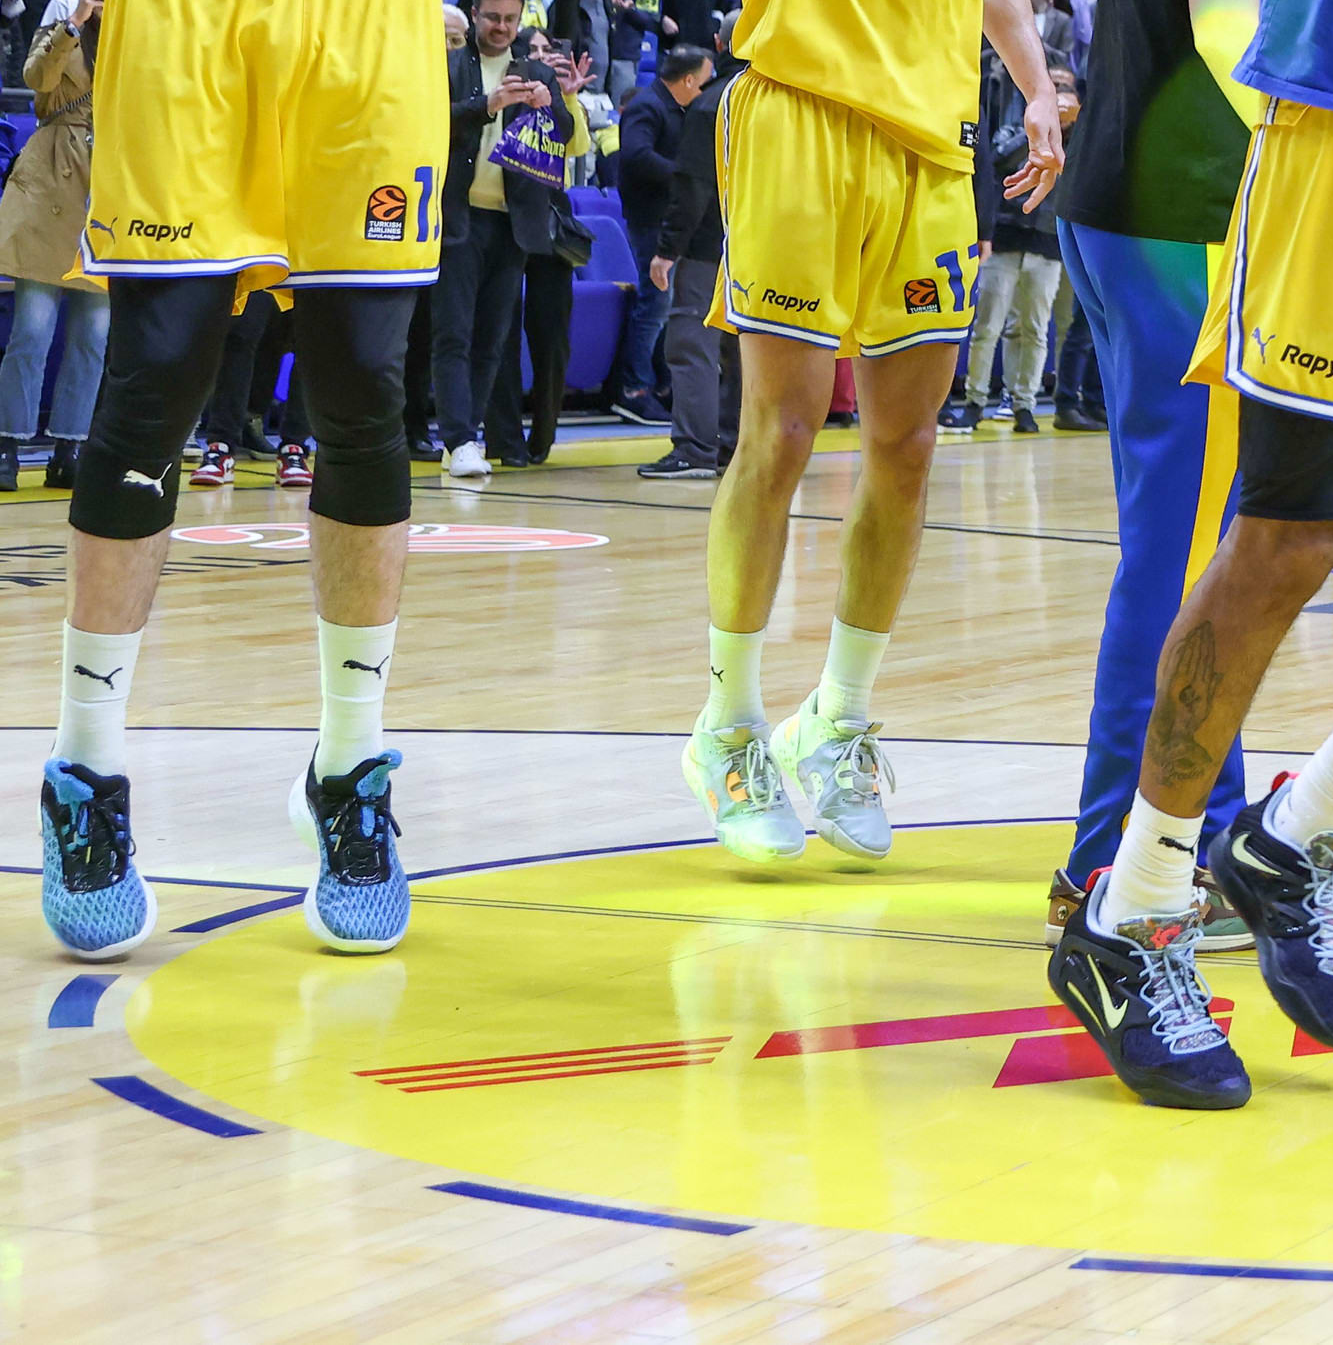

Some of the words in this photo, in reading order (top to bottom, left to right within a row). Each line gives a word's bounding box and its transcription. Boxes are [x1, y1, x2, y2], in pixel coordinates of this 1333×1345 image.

[414, 165, 440, 243] 1
[127, 218, 194, 244] Rapyd
[369, 220, 402, 228] TURKISH
[761, 285, 822, 315] Rapyd
